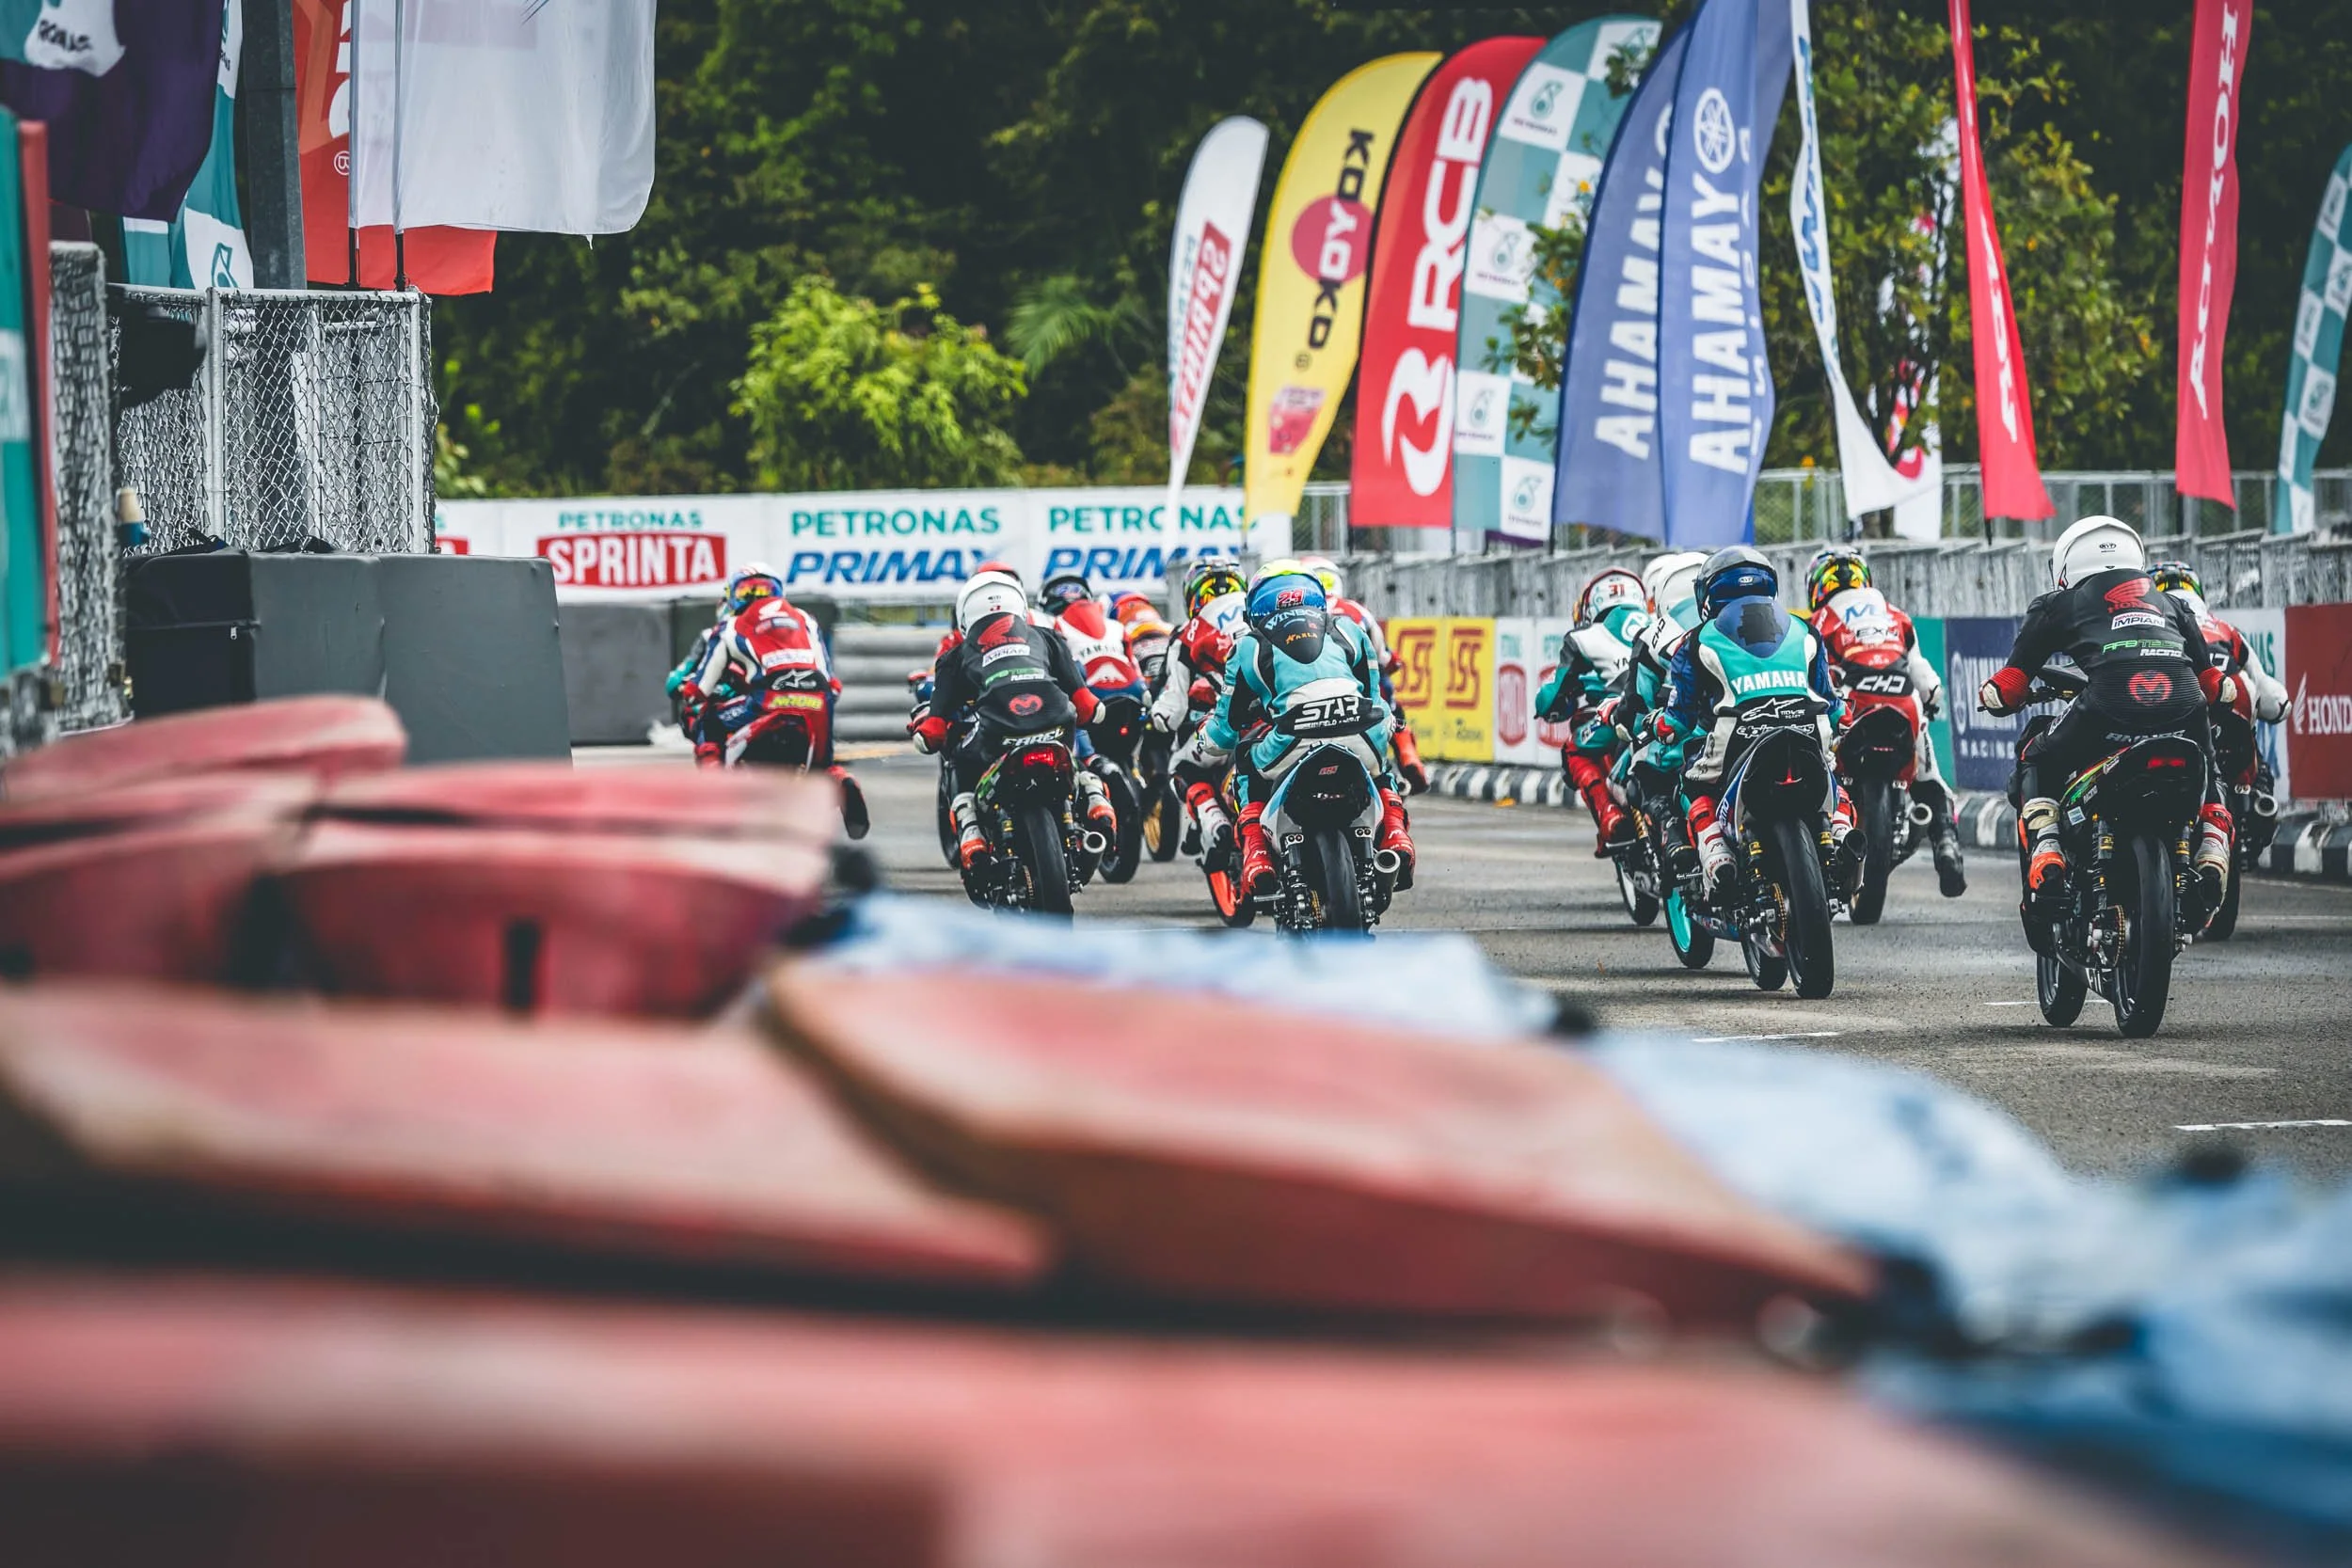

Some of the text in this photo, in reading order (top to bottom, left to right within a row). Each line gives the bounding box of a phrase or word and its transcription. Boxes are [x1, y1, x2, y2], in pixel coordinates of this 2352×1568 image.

[1407, 76, 1494, 332] RCB
[558, 510, 703, 530] PETRONAS
[791, 508, 1000, 536] PETRONAS
[546, 534, 718, 585] SPRINTA
[1042, 546, 1243, 580] PRIM
[1731, 670, 1808, 695] YAMAHA
[1295, 696, 1359, 723] STAR
